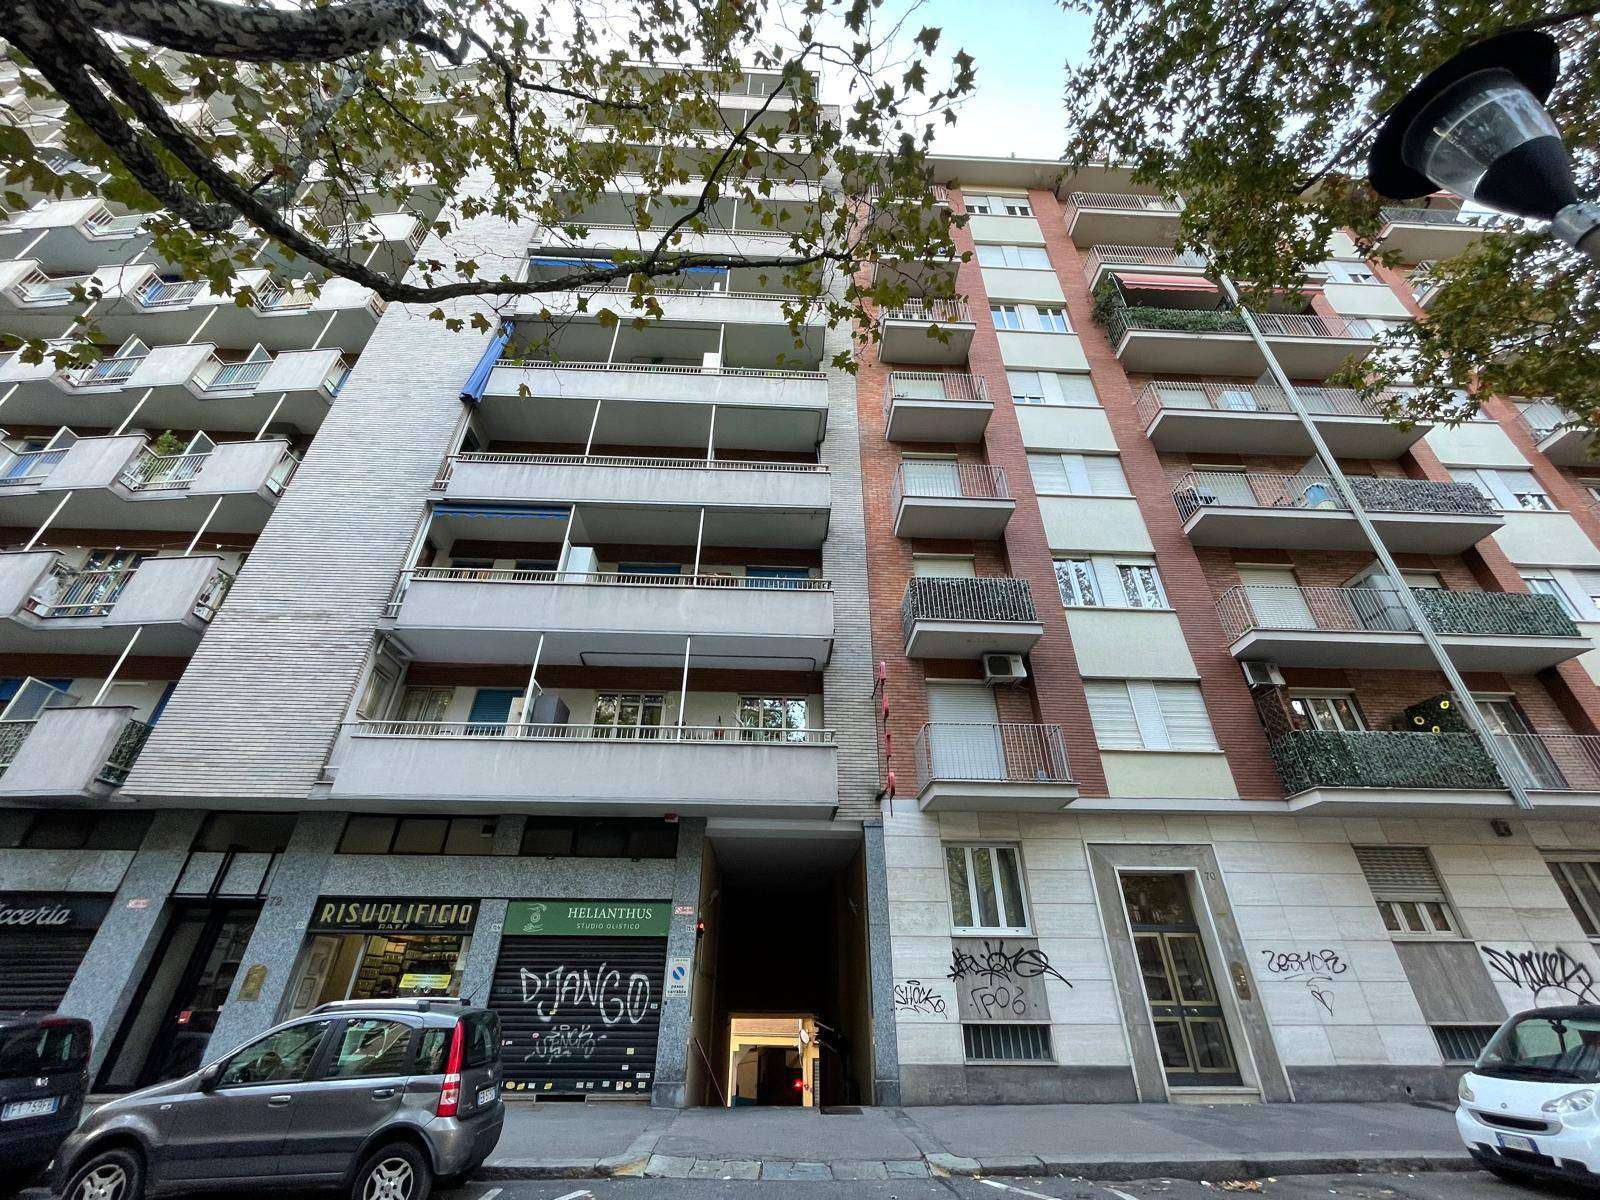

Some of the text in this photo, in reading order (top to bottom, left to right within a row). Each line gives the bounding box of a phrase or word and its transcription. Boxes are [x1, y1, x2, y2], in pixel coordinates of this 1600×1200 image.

[1204, 872, 1216, 881] 70
[320, 903, 473, 924] RISUOLIFICIO
[567, 907, 654, 919] HELIANTHUS
[576, 922, 604, 930] STUDIO
